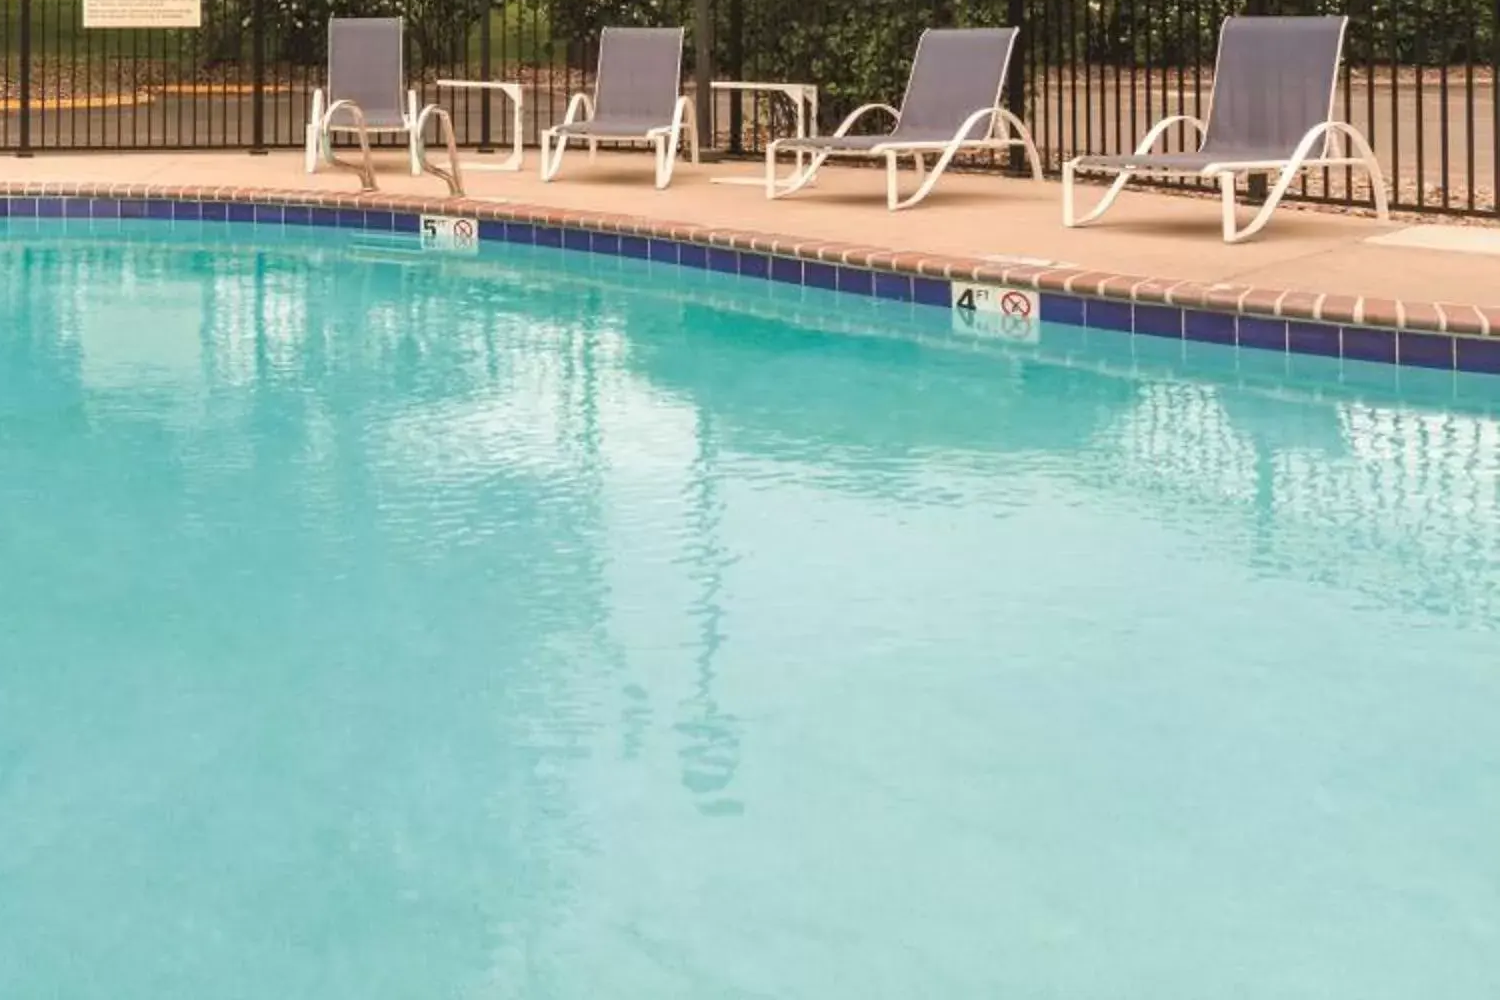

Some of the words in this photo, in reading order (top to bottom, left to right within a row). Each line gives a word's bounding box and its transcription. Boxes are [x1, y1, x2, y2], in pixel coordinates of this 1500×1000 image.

[424, 219, 436, 239] 5
[957, 288, 976, 310] 4
[976, 289, 989, 301] FT
